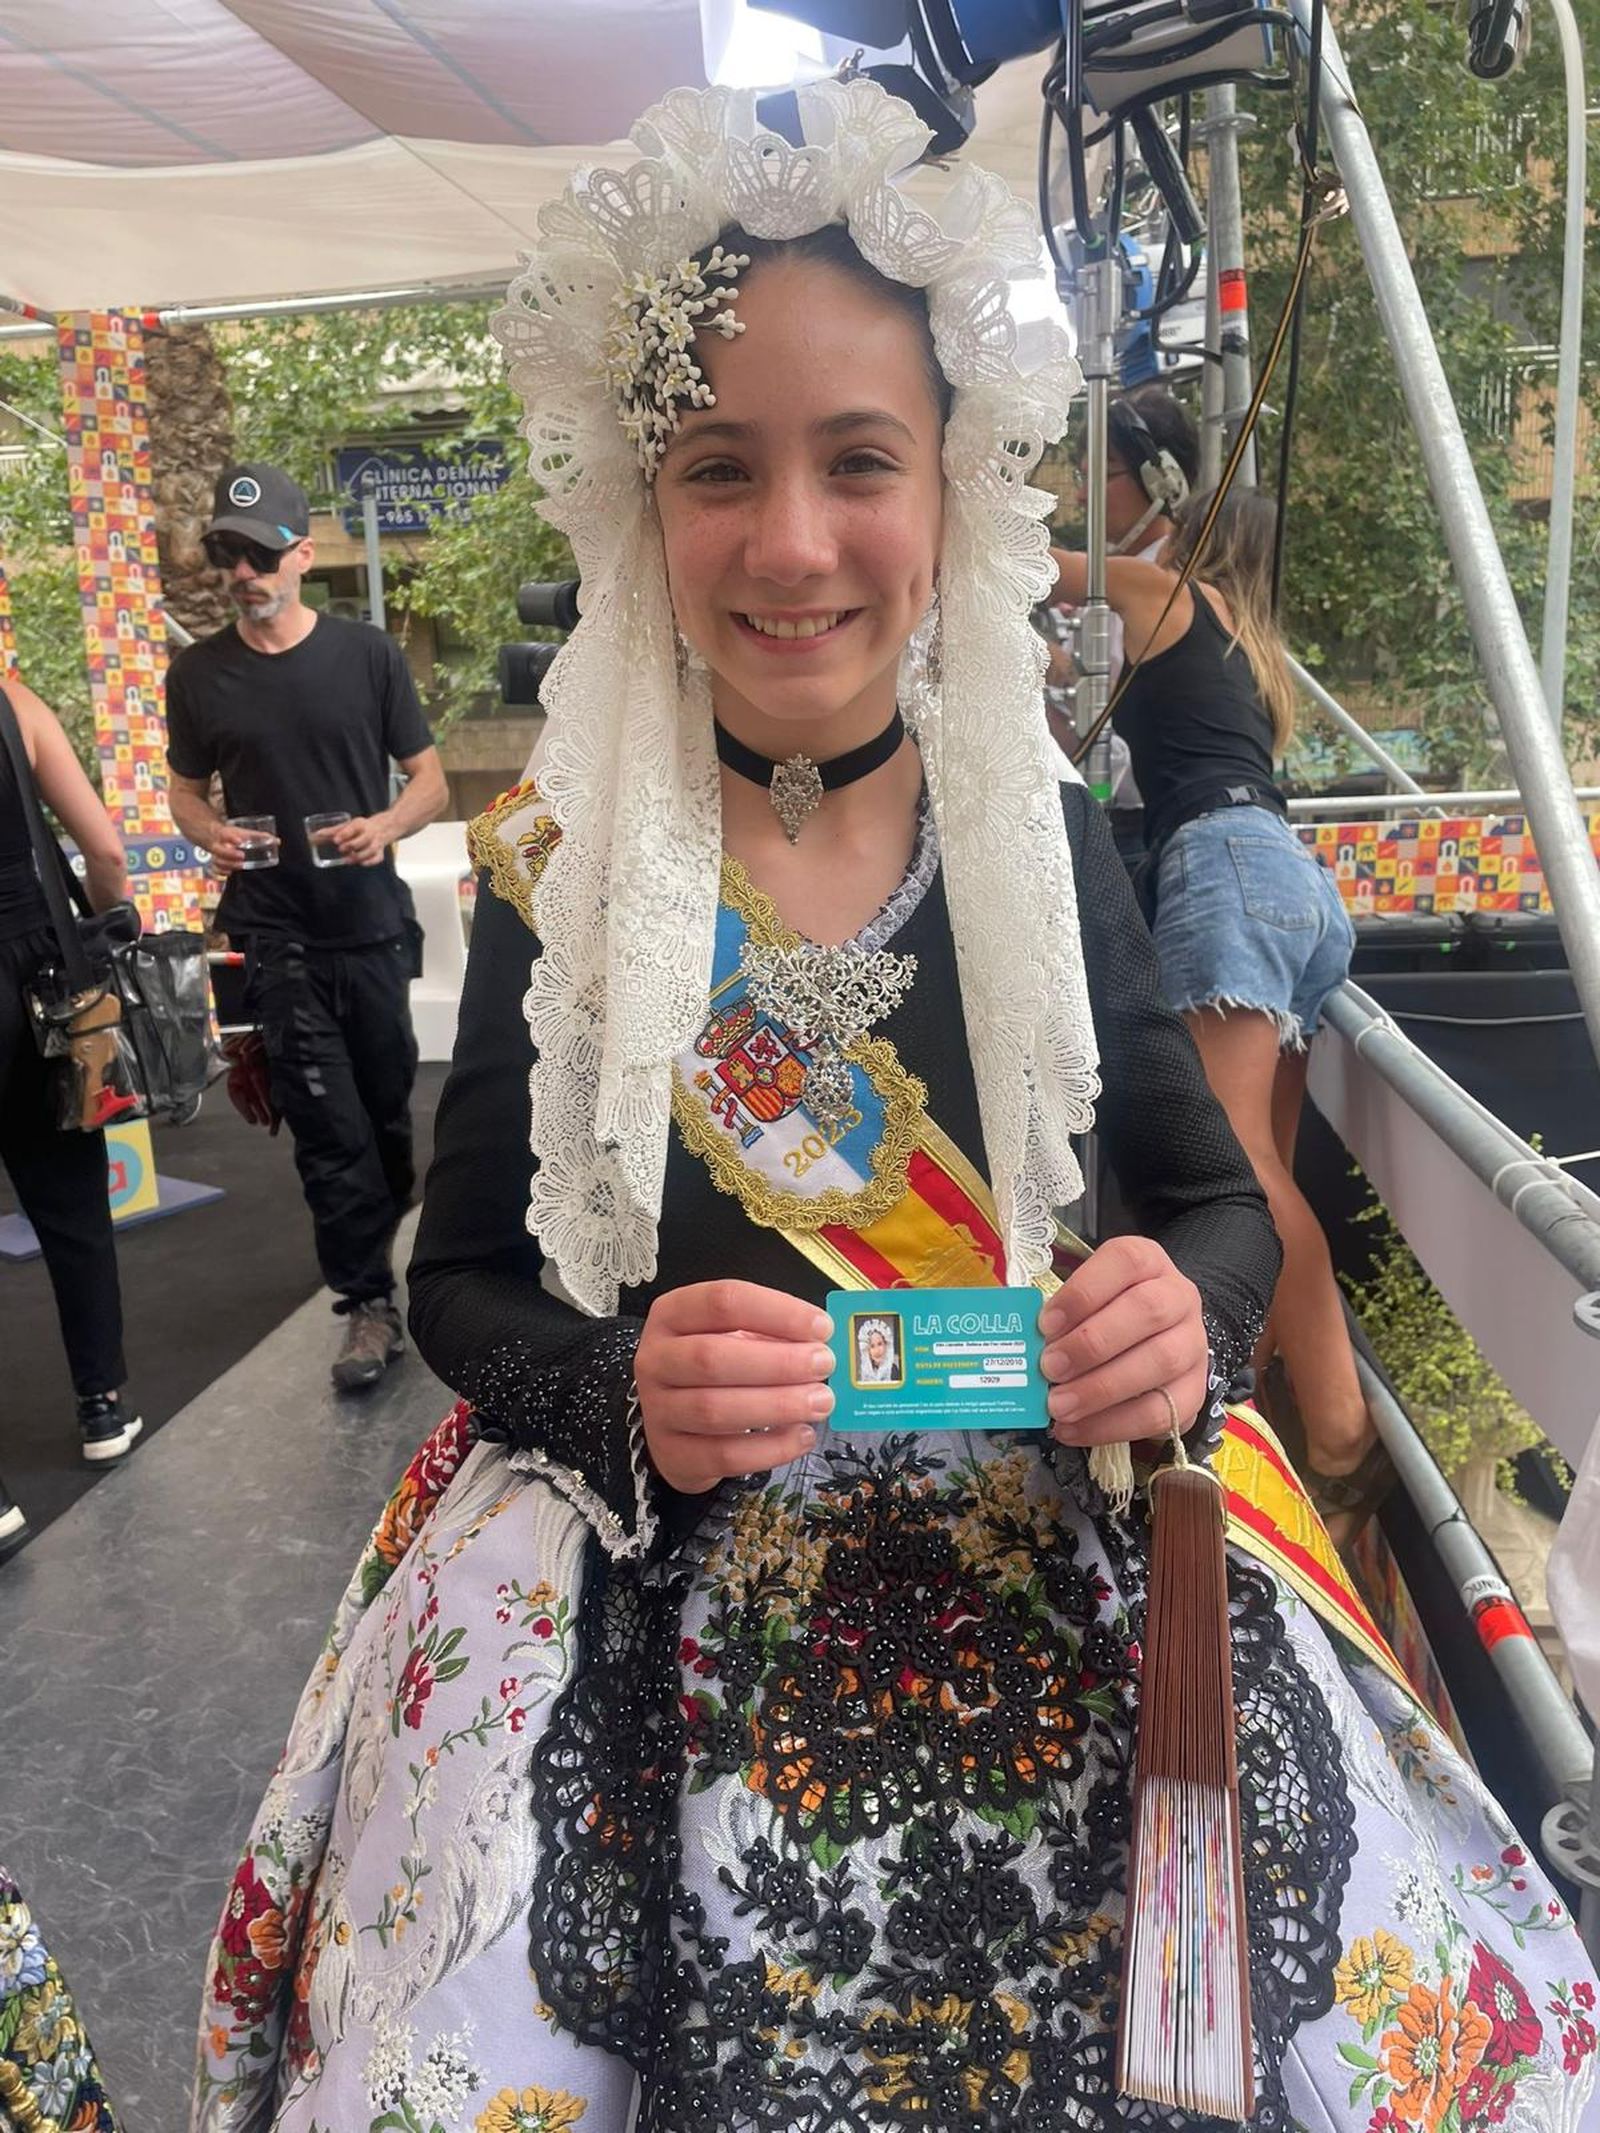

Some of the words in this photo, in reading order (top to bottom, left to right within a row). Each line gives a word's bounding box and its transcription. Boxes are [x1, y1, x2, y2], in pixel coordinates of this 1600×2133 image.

[437, 465, 500, 480] DENTAL
[913, 1315, 942, 1335] LA
[947, 1313, 1023, 1334] COLLA
